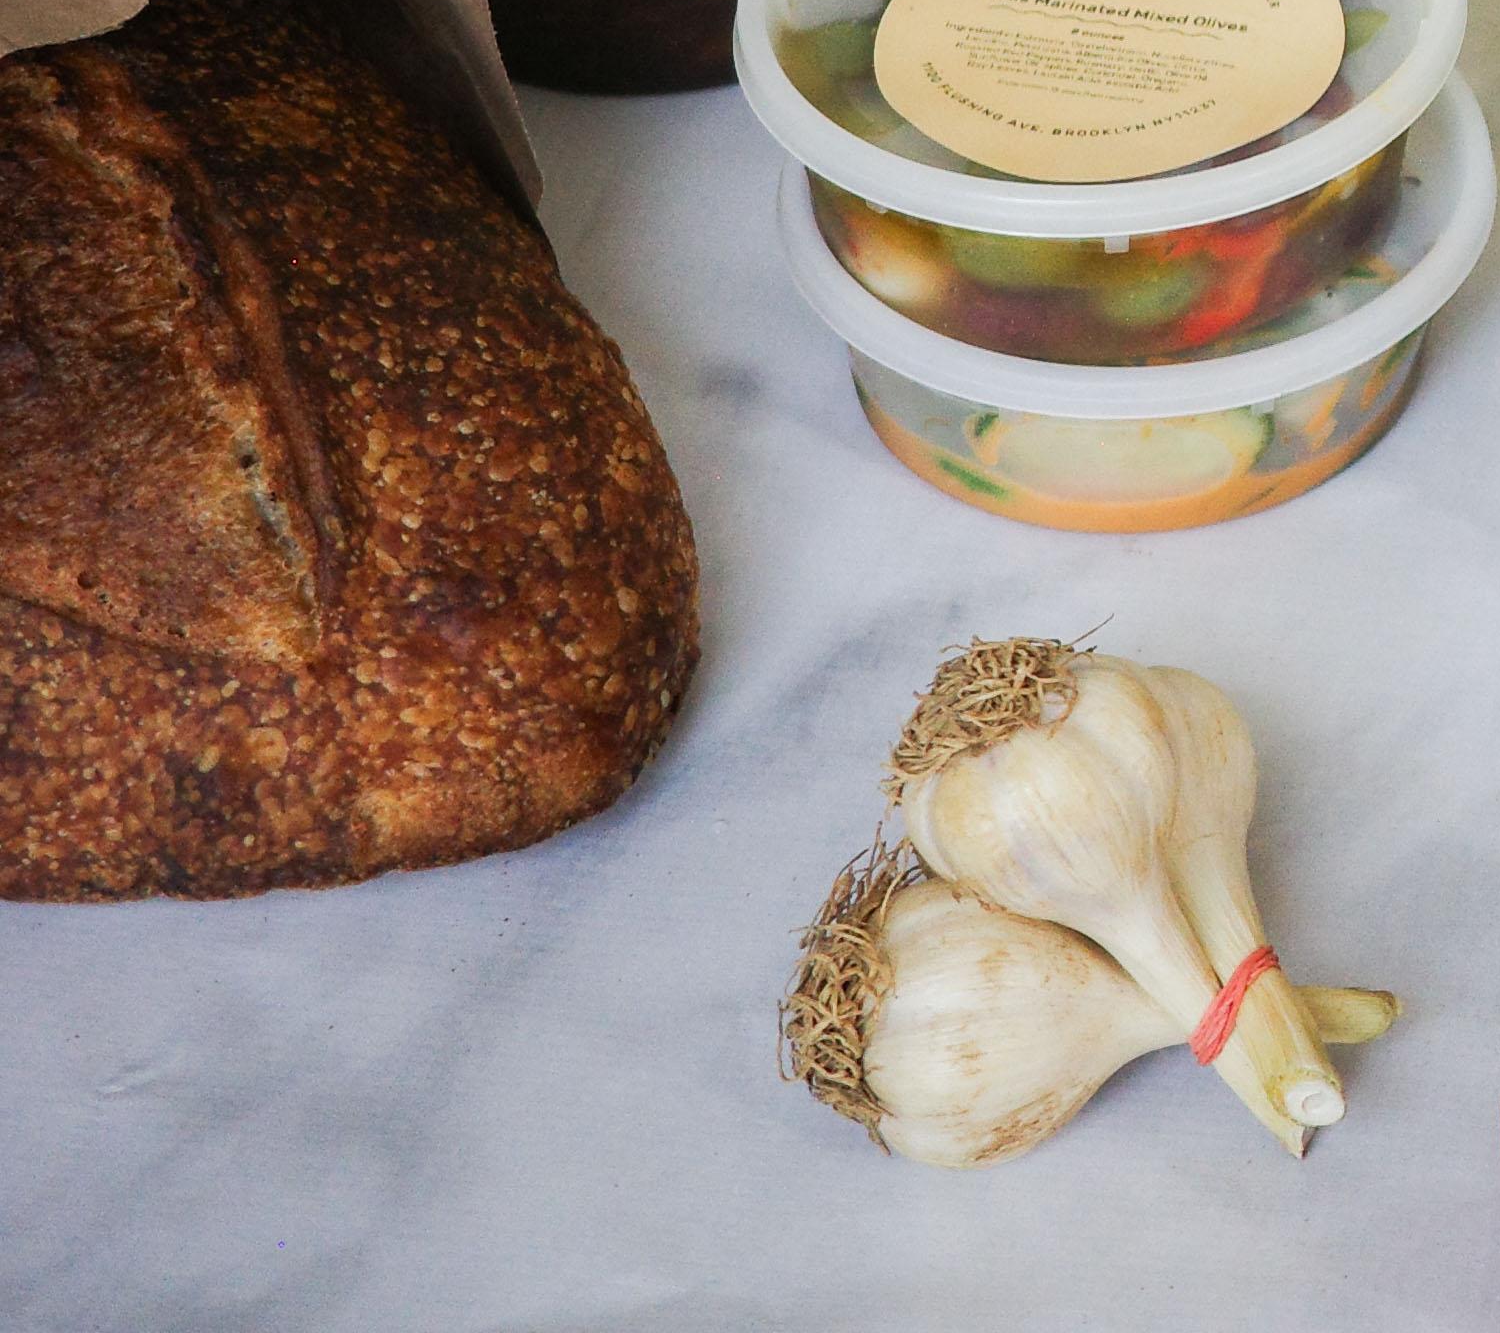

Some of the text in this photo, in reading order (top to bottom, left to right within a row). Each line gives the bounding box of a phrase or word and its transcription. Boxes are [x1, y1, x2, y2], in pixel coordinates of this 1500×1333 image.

[1134, 8, 1190, 26] Mixed
[1193, 16, 1250, 34] Olives
[1051, 123, 1147, 138] BROOKLYN
